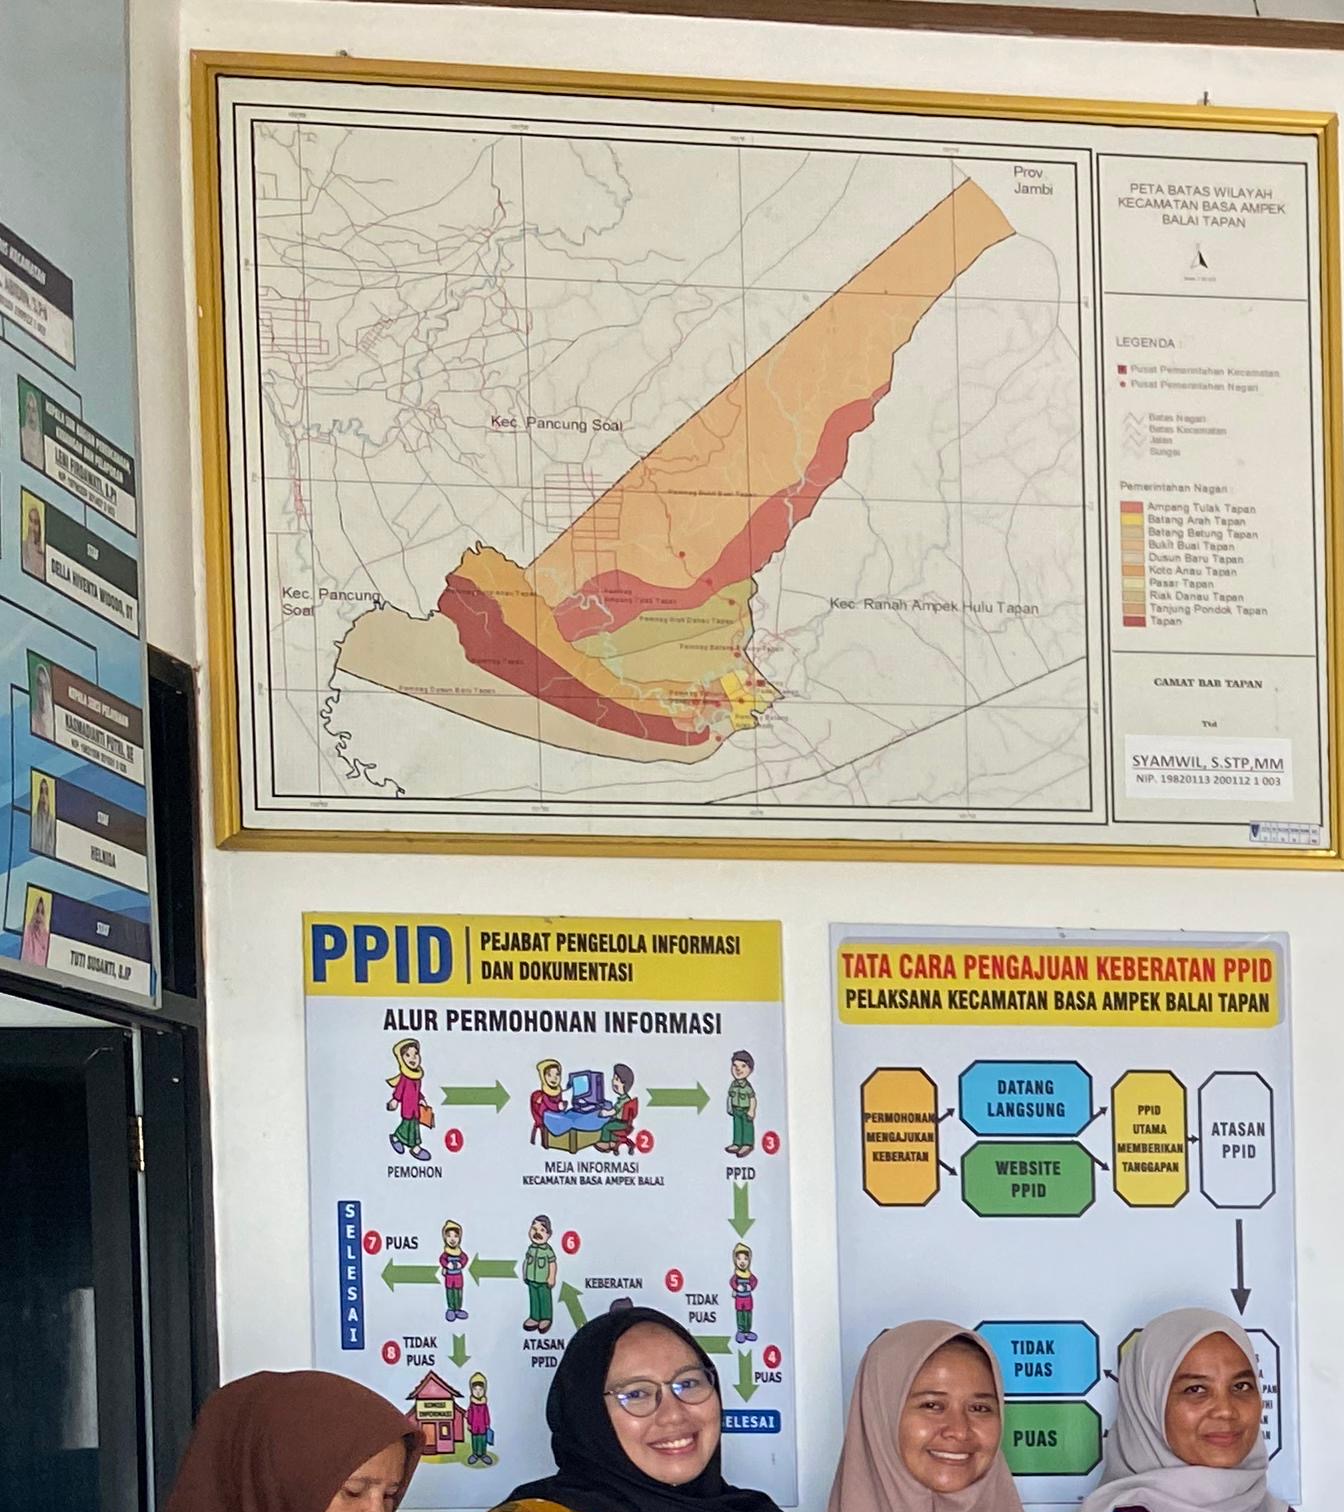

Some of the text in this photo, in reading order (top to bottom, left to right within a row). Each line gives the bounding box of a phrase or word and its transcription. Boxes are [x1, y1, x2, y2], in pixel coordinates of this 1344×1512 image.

[1014, 182, 1053, 195] Jambi
[1130, 183, 1273, 200] PETA BATAS WILAYAH
[1118, 197, 1286, 215] KECAMATAN BASA AMPEK
[1162, 214, 1246, 228] BALAI TAPAN
[1116, 337, 1176, 348] LEGENDA
[526, 416, 624, 433] Pancung Soal
[1120, 480, 1191, 493] Pemerintahan
[1147, 502, 1190, 513] Ampang
[1224, 504, 1256, 515] Tapan
[1148, 514, 1246, 527] Batang Tapan
[1148, 527, 1184, 539] Batang
[1227, 529, 1258, 541] Tapan
[1204, 541, 1235, 552] Tapan
[1212, 554, 1244, 566] Tapan
[1205, 567, 1237, 578] Tapan
[1149, 578, 1215, 590] Pasar Tapan
[282, 586, 382, 603] Kec. Pancung
[1212, 592, 1244, 603] Tapan
[282, 604, 314, 616] Soal
[863, 598, 1039, 615] Ranah Ampek Hulu Tapan
[1150, 603, 1268, 617] Tanjung Pondok Tapan
[1150, 616, 1182, 627] Tapan
[1154, 678, 1263, 689] CAMAT TAPAN
[1132, 755, 1284, 771] SYAMWIL, S.STP,MM
[1161, 774, 1210, 785] 19820113
[1213, 775, 1251, 786] 200112
[1254, 776, 1260, 786] 1
[1262, 777, 1281, 786] 003
[480, 932, 740, 955] PEJABAT PENGELOLA INFORMASI
[311, 923, 454, 985] PPID
[481, 962, 633, 982] DAN DOKUMENTASI
[842, 952, 1273, 983] TATA CARA PENGAJUAN KEBERATAN PPID
[846, 988, 1270, 1013] PELAKSANA KECAMATAN BASA AMPEK BALAI TAPAN
[383, 1008, 722, 1035] ALUR PERMOHONAN INFORMASI
[998, 1079, 1054, 1095] DATANG
[987, 1101, 1065, 1118] LANGSUNG
[1137, 1104, 1161, 1116] PPID
[864, 1111, 936, 1124] PERMOHONAN
[1133, 1123, 1167, 1135] UTAMA
[1211, 1121, 1266, 1137] ATASAN
[449, 1134, 458, 1147] 1
[640, 1135, 650, 1148] 2
[767, 1136, 776, 1149] 3
[866, 1131, 935, 1143] MENGAJUKAN
[1117, 1142, 1184, 1155] MEMBERIKAN
[1222, 1144, 1257, 1160] PPID
[872, 1150, 929, 1162] KEBERATAN
[387, 1165, 443, 1179] PEMOHON
[545, 1160, 639, 1174] MEJA INFORMASI
[726, 1166, 756, 1181] PPID
[995, 1160, 1061, 1177] WEBSITE
[1122, 1161, 1180, 1173] TANGGAPAN
[522, 1175, 664, 1187] KECAMATAN BASA AMPEK BALAI
[1011, 1183, 1047, 1199] PPID
[368, 1236, 418, 1250] 7 PUAS
[567, 1236, 576, 1250] 6
[344, 1203, 358, 1343] SELESAI
[585, 1277, 642, 1290] KEBERATAN
[670, 1273, 679, 1287] 5
[685, 1293, 718, 1306] TIDAK
[689, 1310, 716, 1323] PUAS
[403, 1336, 438, 1349] TIDAK
[523, 1337, 565, 1350] ATASAN
[1010, 1340, 1055, 1356] TIDAK
[387, 1346, 396, 1360] 8
[768, 1350, 777, 1364] 4
[406, 1354, 435, 1366] PUAS
[531, 1355, 557, 1368] PPID
[1014, 1362, 1053, 1378] PUAS
[755, 1371, 782, 1383] PUAS
[724, 1416, 775, 1429] ELESAI
[1013, 1430, 1058, 1448] PUAS
